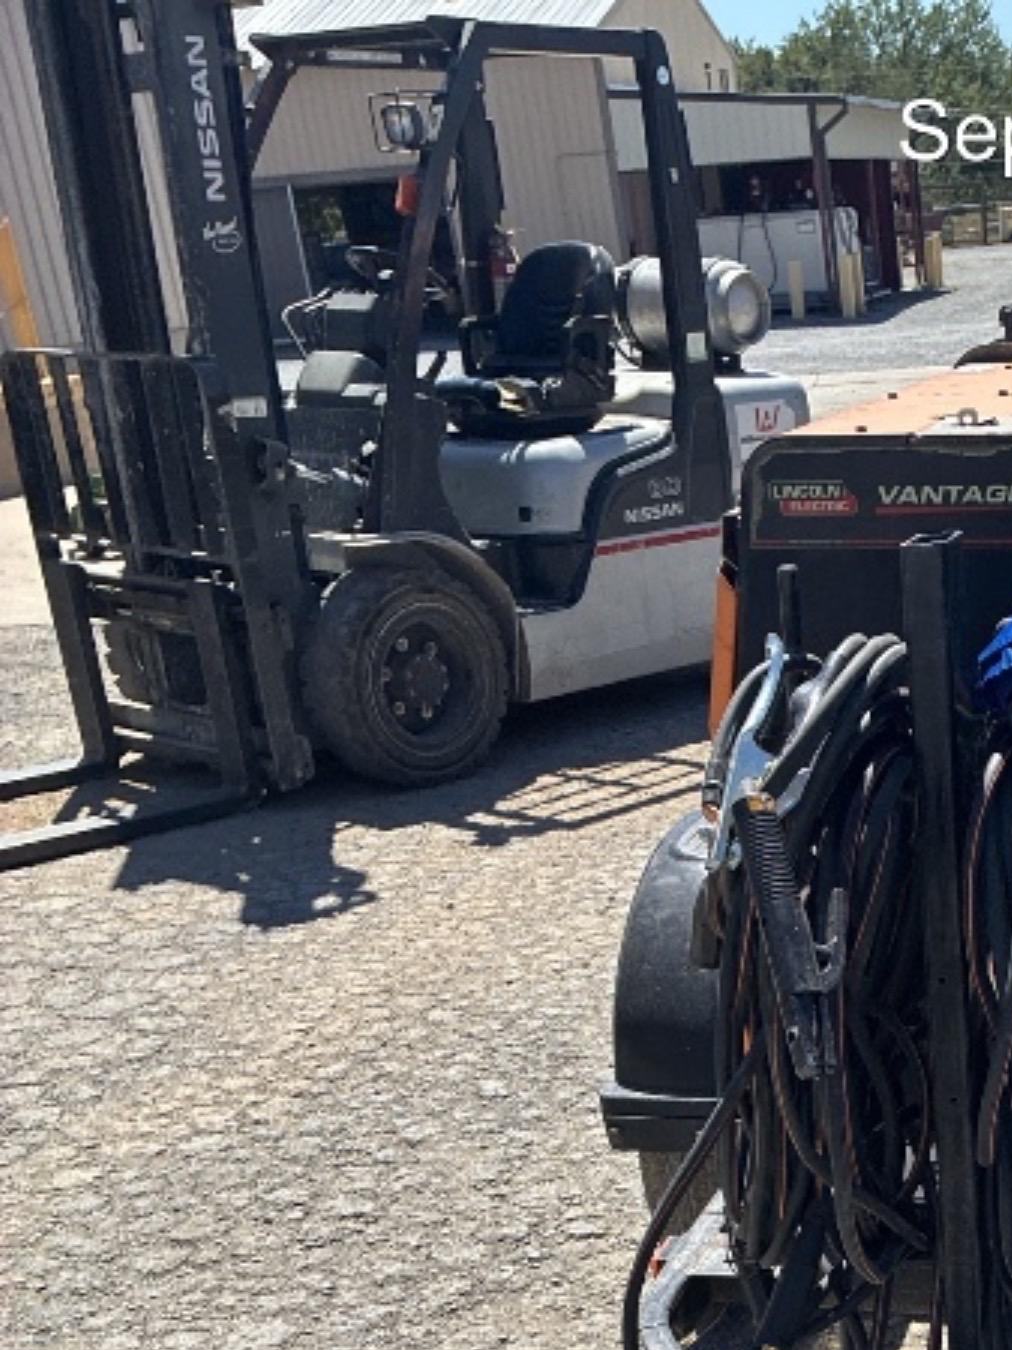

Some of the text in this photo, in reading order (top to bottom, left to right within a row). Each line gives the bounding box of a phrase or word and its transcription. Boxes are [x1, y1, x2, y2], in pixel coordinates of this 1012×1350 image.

[184, 34, 227, 202] NISSAN
[773, 484, 842, 499] LINCOLN
[623, 502, 685, 524] NISSAN
